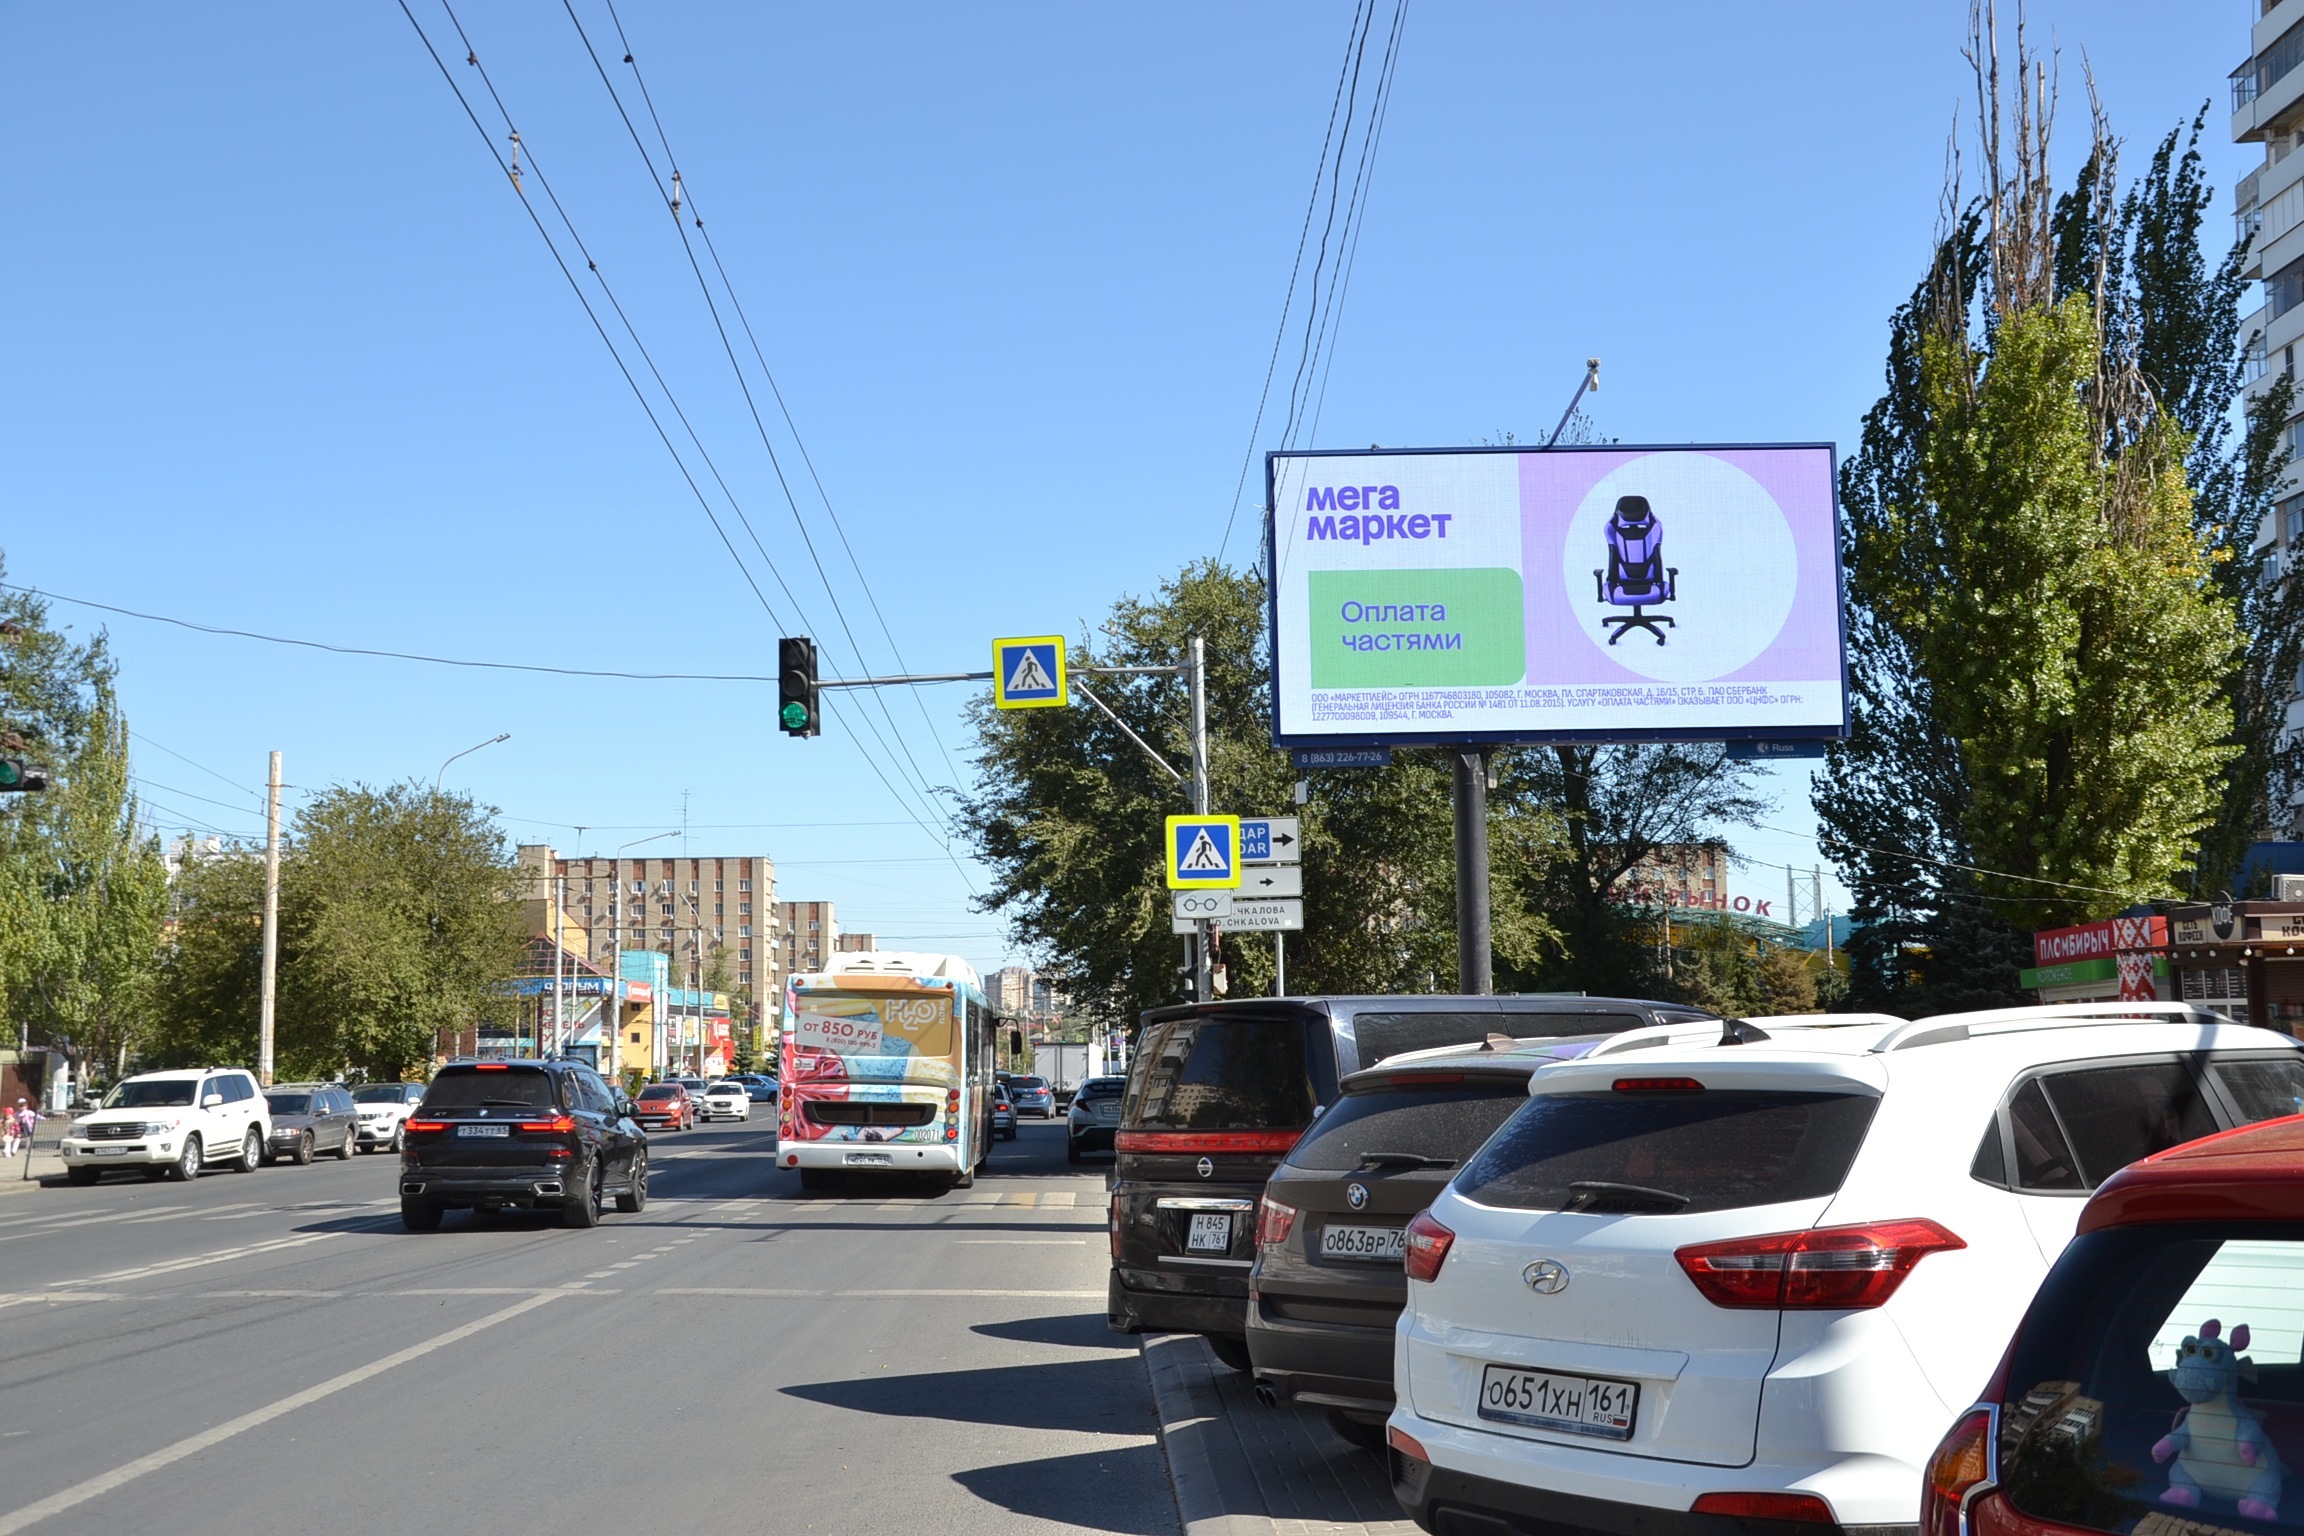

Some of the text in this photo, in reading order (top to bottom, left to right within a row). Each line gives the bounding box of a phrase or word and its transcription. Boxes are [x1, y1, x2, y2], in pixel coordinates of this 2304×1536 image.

[1306, 485, 1400, 511] мега
[1307, 513, 1452, 546] маркет
[1341, 601, 1446, 623] Оплата
[1342, 632, 1462, 651] частями
[1311, 693, 1329, 702] ООО
[1330, 690, 1397, 702] «МАРКЕТПЛЕЙС»
[1398, 691, 1420, 701] ОГРН
[1485, 690, 1516, 700] 105082,
[1517, 689, 1523, 699] Г.
[1524, 689, 1560, 699] МОСКВА,
[1561, 688, 1574, 698] ПЛ.
[1576, 688, 1645, 698] СПАРТАКОВСКАЯ,
[1656, 687, 1679, 697] 16/15,
[1680, 687, 1697, 696] СТР.
[1708, 686, 1725, 696] ПАО
[1726, 685, 1768, 695] СБЕРБАНК
[1371, 701, 1414, 713] ЛИЦЕНЗИЯ
[1416, 701, 1442, 710] БАНКА
[1443, 700, 1477, 710] РОССИИ
[1478, 700, 1487, 709] №
[1488, 699, 1506, 709] 1481
[1508, 699, 1518, 708] ОТ
[1567, 697, 1596, 707] УСЛУГУ
[1597, 697, 1632, 707] «ОПЛАТА
[1633, 696, 1676, 706] ЧАСТЯМИ»
[1677, 695, 1725, 706] ОКАЗЫВАЕТ
[1726, 695, 1744, 705] ООО
[1780, 694, 1804, 704] ОГРН:
[1411, 710, 1418, 719] Г.
[1418, 709, 1454, 719] МОСКВА.
[1771, 743, 1795, 752] Russ
[1301, 751, 1383, 764] 8 (863) 226-77-26
[1237, 906, 1285, 916] ЧКАЛОВА
[1668, 888, 1773, 917] РЫНОК
[1227, 917, 1280, 927] CHKALOVA
[2211, 904, 2233, 926] КОФЕ
[2040, 929, 2110, 960] ПЛОМБИРЫЧ
[803, 1020, 878, 1041] ОТ 850 РУБ
[914, 1129, 940, 1141] 002071
[1196, 1217, 1224, 1230] Н 845
[1191, 1233, 1226, 1247] НК 761
[1326, 1229, 1386, 1254] О863ВР
[1489, 1375, 1628, 1418] О651ХН 161
[1593, 1412, 1612, 1424] RUS
